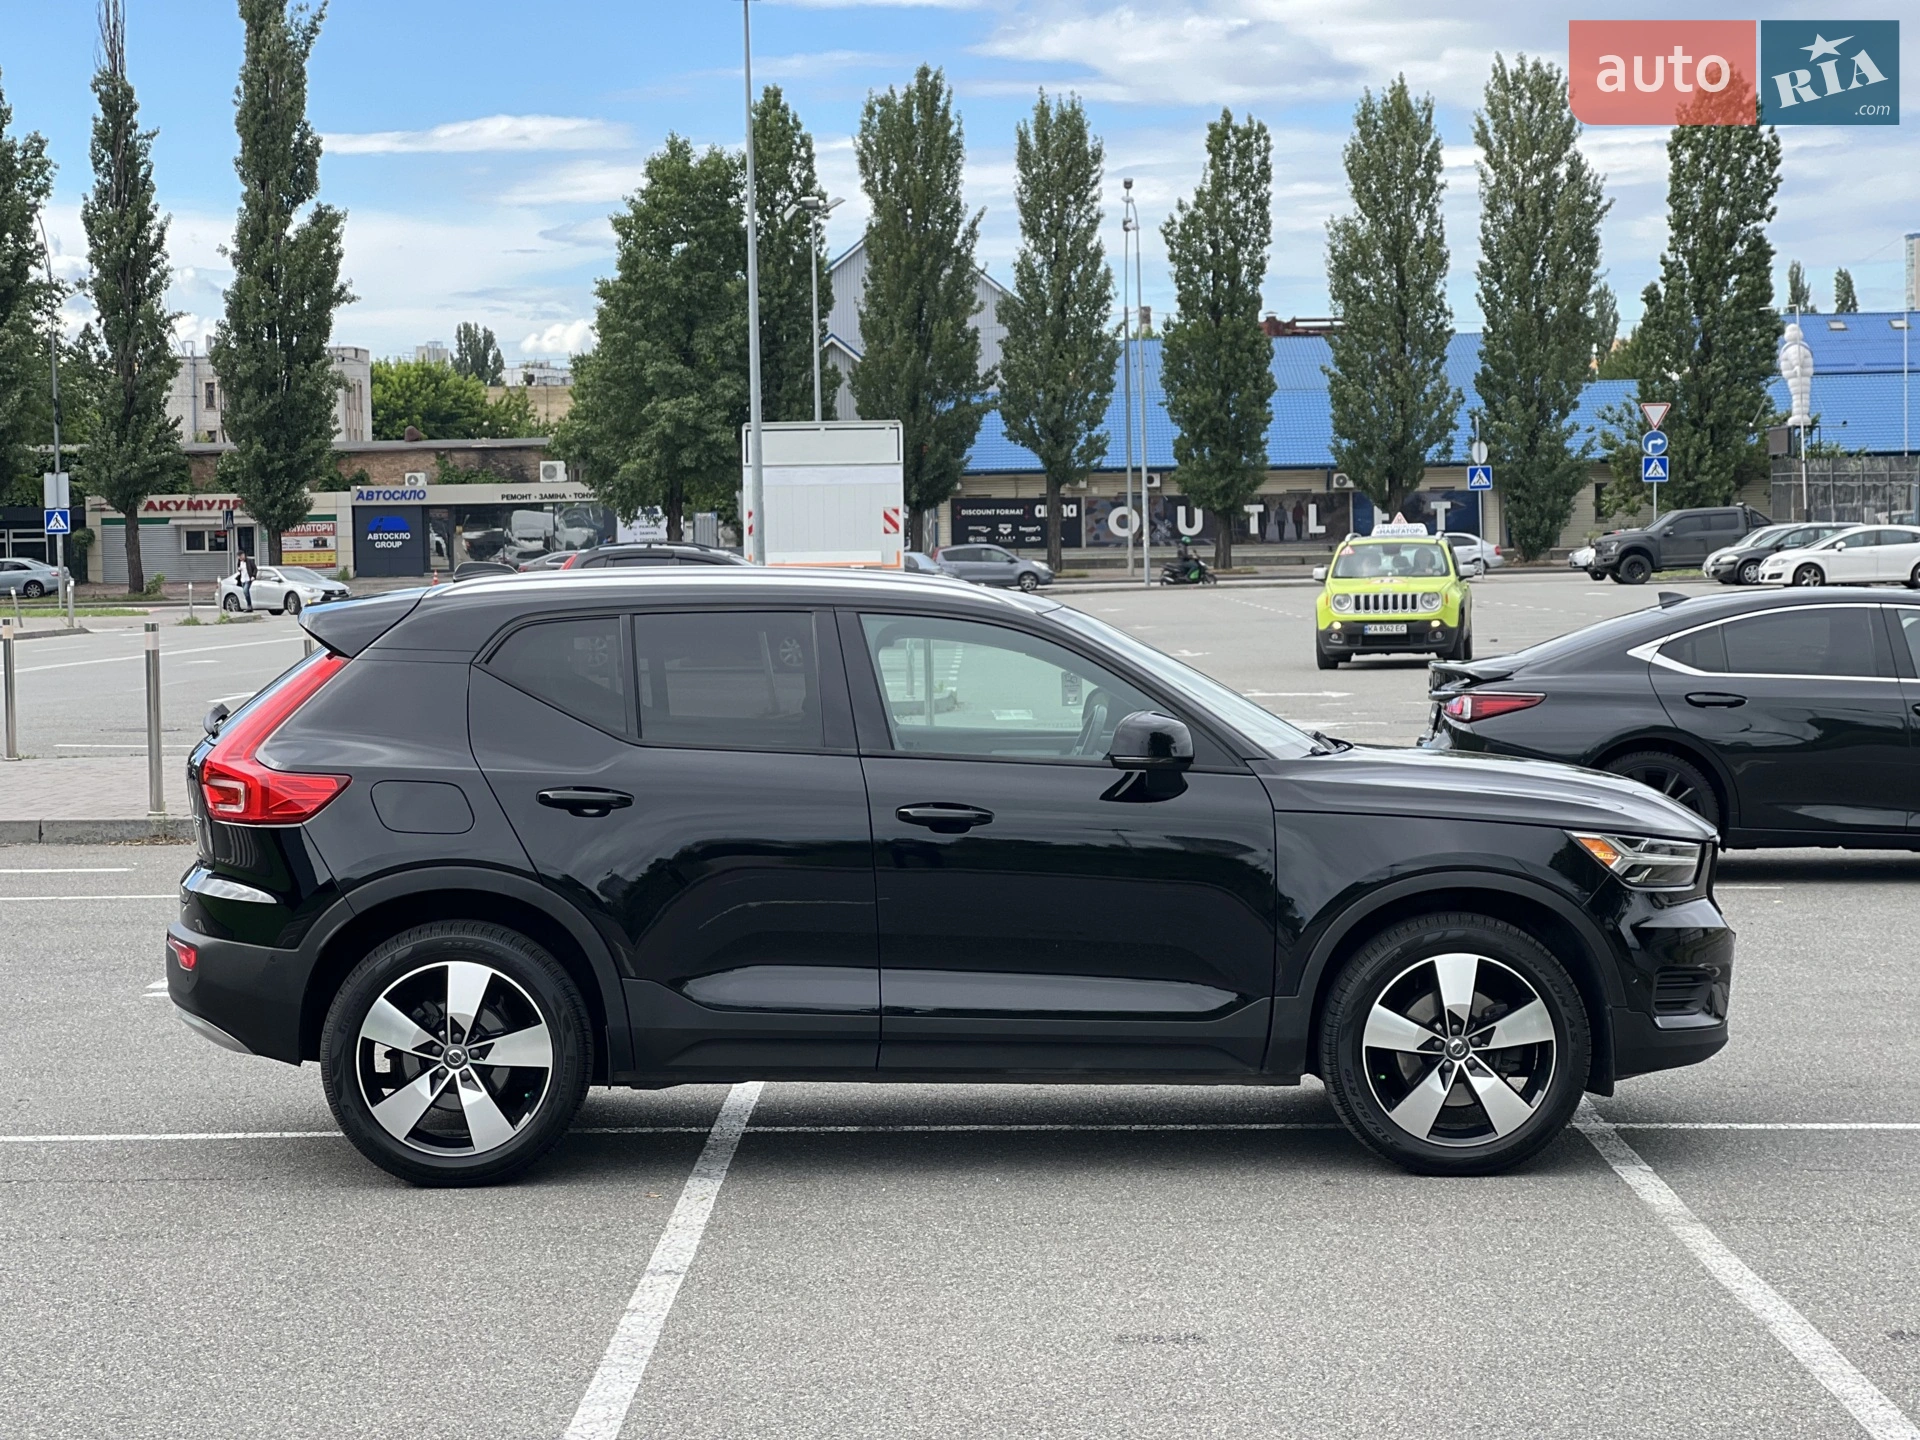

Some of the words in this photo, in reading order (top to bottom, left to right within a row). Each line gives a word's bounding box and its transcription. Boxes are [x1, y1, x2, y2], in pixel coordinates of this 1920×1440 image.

[355, 489, 427, 501] АВТОСКЛО
[501, 493, 532, 501] РЕМОНТ
[538, 492, 567, 500] ЗАМІНА
[143, 499, 244, 512] АКУМУЛЯ
[961, 508, 995, 516] DISCOUNT
[996, 508, 1024, 516] FORMAT
[367, 532, 411, 541] АВТОСКЛО
[374, 541, 403, 549] GROUP
